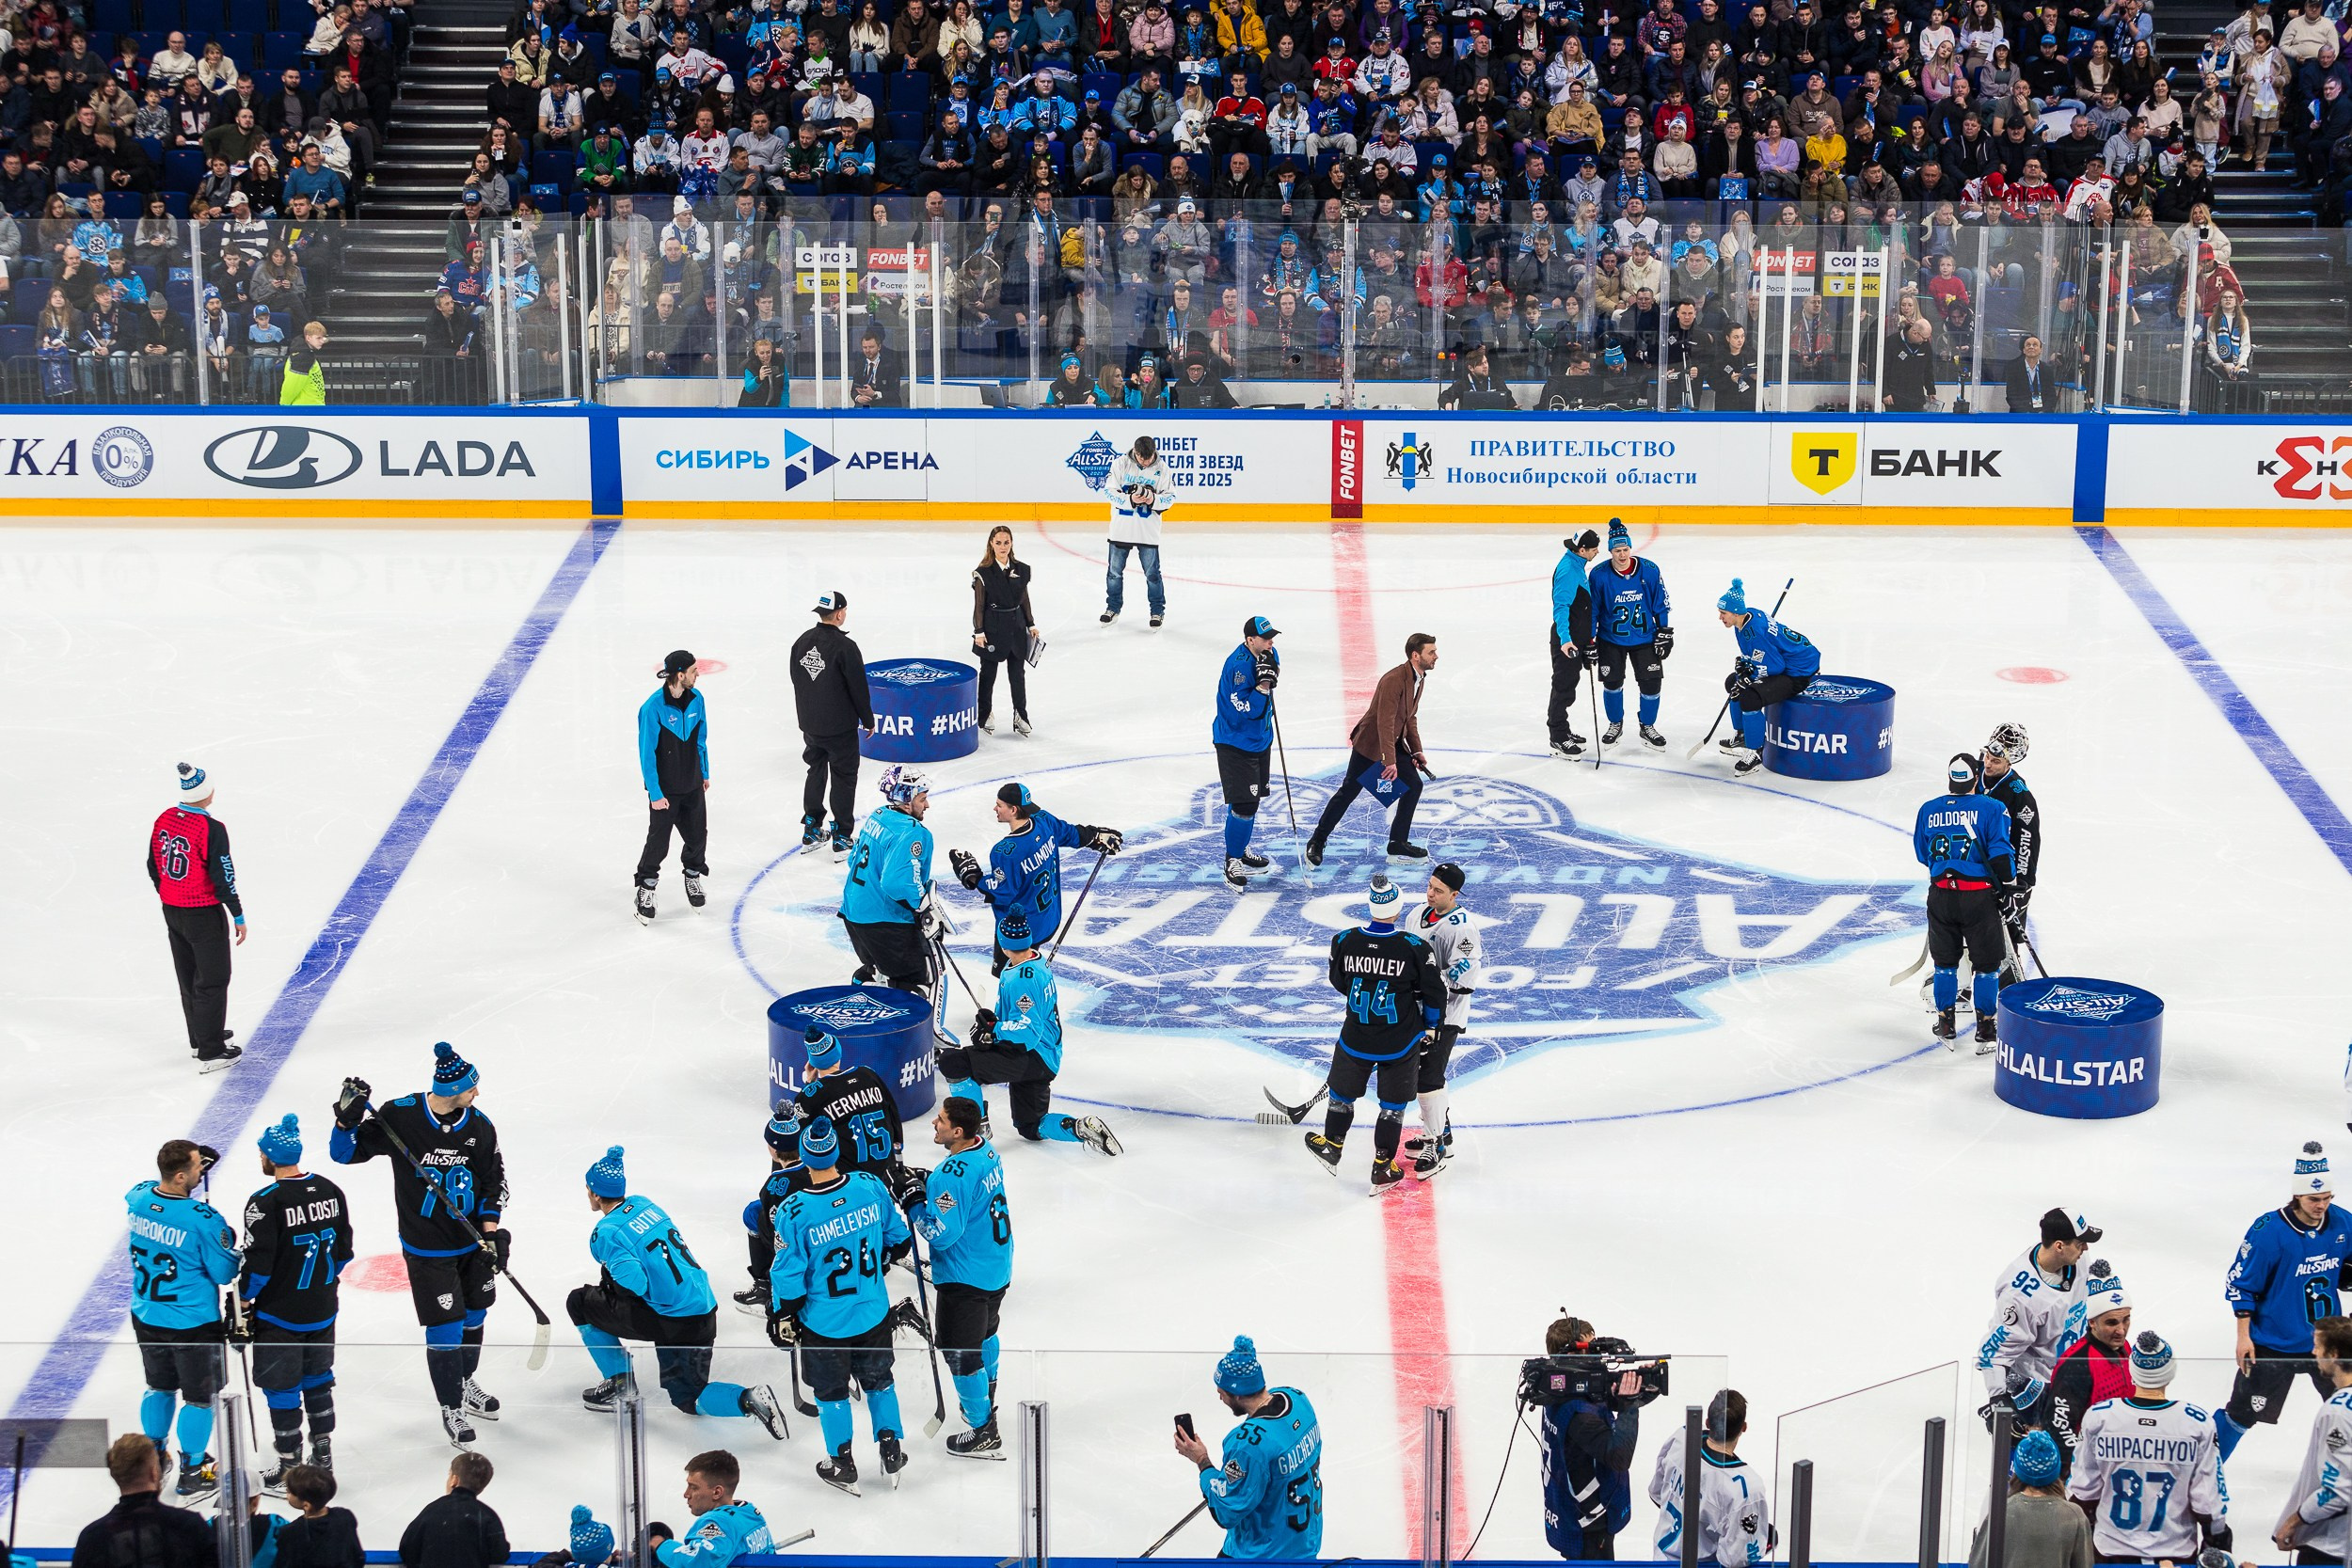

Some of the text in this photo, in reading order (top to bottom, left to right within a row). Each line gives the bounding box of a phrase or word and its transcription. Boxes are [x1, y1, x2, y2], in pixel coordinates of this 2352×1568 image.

[1755, 255, 1815, 268] FONET
[880, 281, 926, 290] Ростелом
[0, 438, 79, 476] КА
[1152, 437, 1198, 451] ОНБЕТ
[1470, 439, 1676, 458] ПРАВИТЕЛЬСТВО
[379, 440, 536, 477] LADA
[656, 450, 771, 469] СИБИРЬ
[845, 451, 940, 470] АРЕНА
[1199, 455, 1244, 471] ЗВЕЗД
[1338, 424, 1357, 500] FONBET
[1870, 449, 2003, 478] БАНК
[1198, 473, 1232, 486] 2025
[1446, 467, 1697, 489] Новосибирской области
[1612, 603, 1649, 638] 24
[1930, 832, 1974, 862] 87
[1448, 912, 1468, 926] 97
[1019, 966, 1034, 979] 16
[1187, 963, 1597, 990] FOET
[1343, 955, 1406, 977] YAKOVLEV
[1348, 976, 1398, 1024] 44
[848, 1109, 892, 1164] 15
[942, 1159, 969, 1178] 65
[416, 1165, 475, 1220] 78
[766, 1176, 791, 1196] 49
[285, 1197, 340, 1227] DA COSTA
[808, 1202, 880, 1248] CHMELEVSKI
[128, 1212, 187, 1248] SHIROKOV
[294, 1227, 337, 1291] 77
[644, 1227, 702, 1287] 78
[823, 1236, 879, 1299] 24
[131, 1243, 178, 1303] 52
[2011, 1270, 2041, 1298] 92
[2303, 1275, 2334, 1327] 6
[1235, 1421, 1267, 1447] 55
[2097, 1436, 2198, 1463] SHIPACHYOV
[2109, 1468, 2176, 1532] 87
